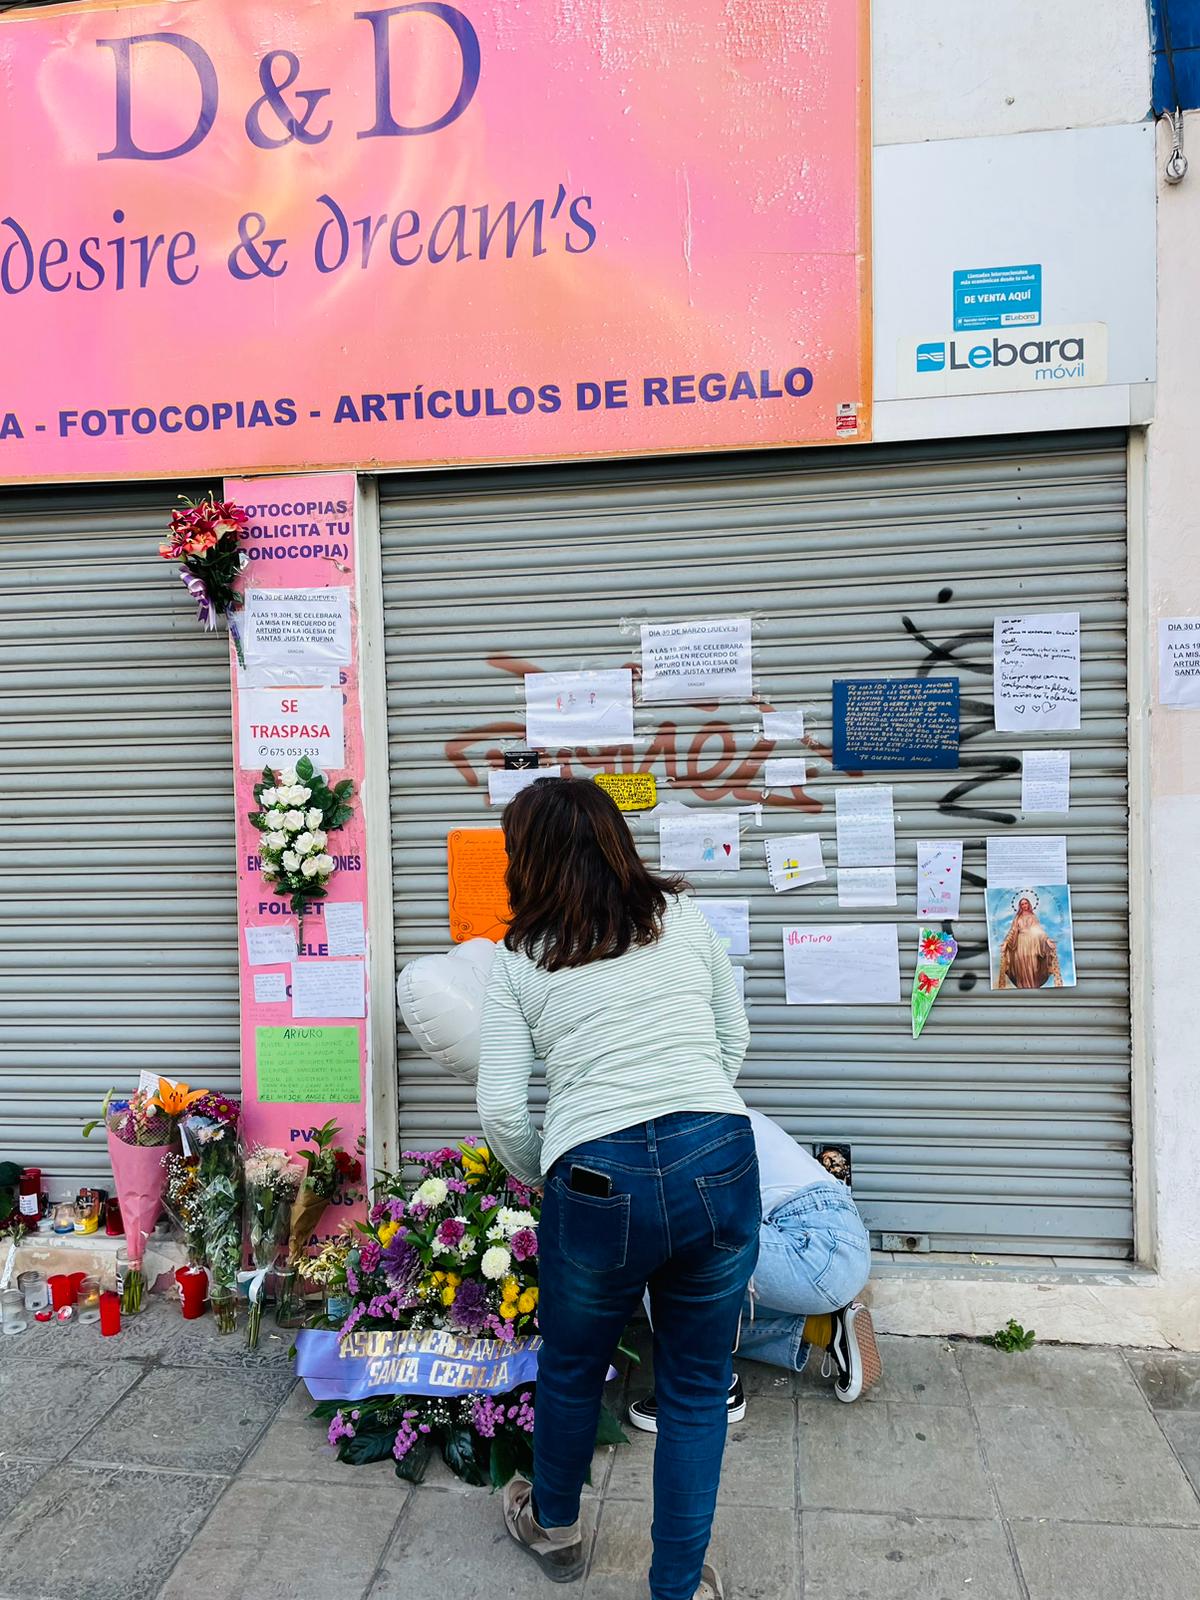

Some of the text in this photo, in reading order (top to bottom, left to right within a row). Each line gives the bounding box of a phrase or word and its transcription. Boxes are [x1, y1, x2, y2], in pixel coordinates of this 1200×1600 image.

[96, 1, 482, 161] D & D
[0, 184, 597, 295] desire & dream's
[964, 288, 1031, 304] DE VENTA AQUÍ
[1011, 313, 1035, 321] Lebara
[950, 338, 1084, 370] Lebara
[1035, 363, 1084, 380] móvil
[59, 397, 298, 437] FOTOCOPIAS
[334, 384, 562, 423] ARTÍCULOS
[577, 379, 629, 412] DE
[643, 366, 814, 407] REGALO
[326, 522, 350, 536] TU
[682, 627, 707, 635] MARZO
[281, 699, 298, 713] SE
[250, 724, 331, 739] TRASPASA
[269, 748, 320, 756] 675 053 533
[859, 753, 869, 761] TE
[283, 1029, 323, 1039] ARTURO
[368, 1357, 509, 1389] SANTA CECILIA
